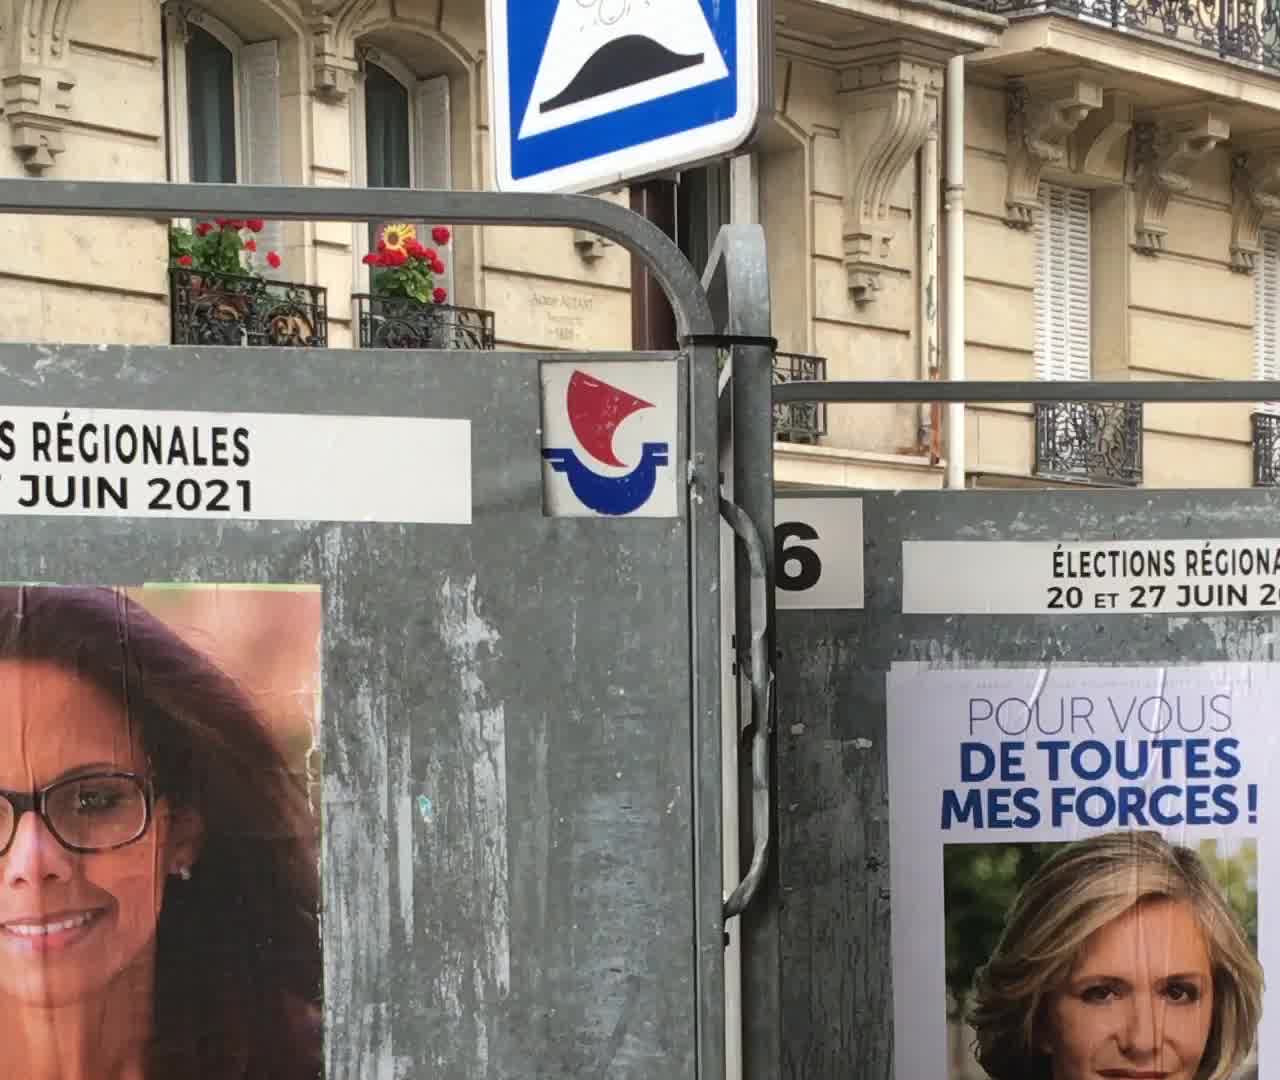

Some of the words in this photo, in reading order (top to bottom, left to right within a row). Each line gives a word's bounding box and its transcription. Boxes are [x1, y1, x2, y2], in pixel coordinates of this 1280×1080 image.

[33, 412, 251, 467] RÉGIONALES
[18, 473, 129, 509] JUIN
[148, 477, 253, 512] 2021
[771, 522, 821, 591] 6
[1051, 544, 1176, 578] ÉLECTIONS
[1046, 586, 1083, 609] 20
[1094, 593, 1119, 608] ET
[1130, 585, 1165, 608] 27
[1177, 584, 1248, 607] JUIN
[969, 697, 1094, 735] POUR
[1108, 694, 1232, 733] VOUS
[960, 741, 1025, 784] DE
[1036, 738, 1241, 782] TOUTES
[941, 788, 1041, 830] MES
